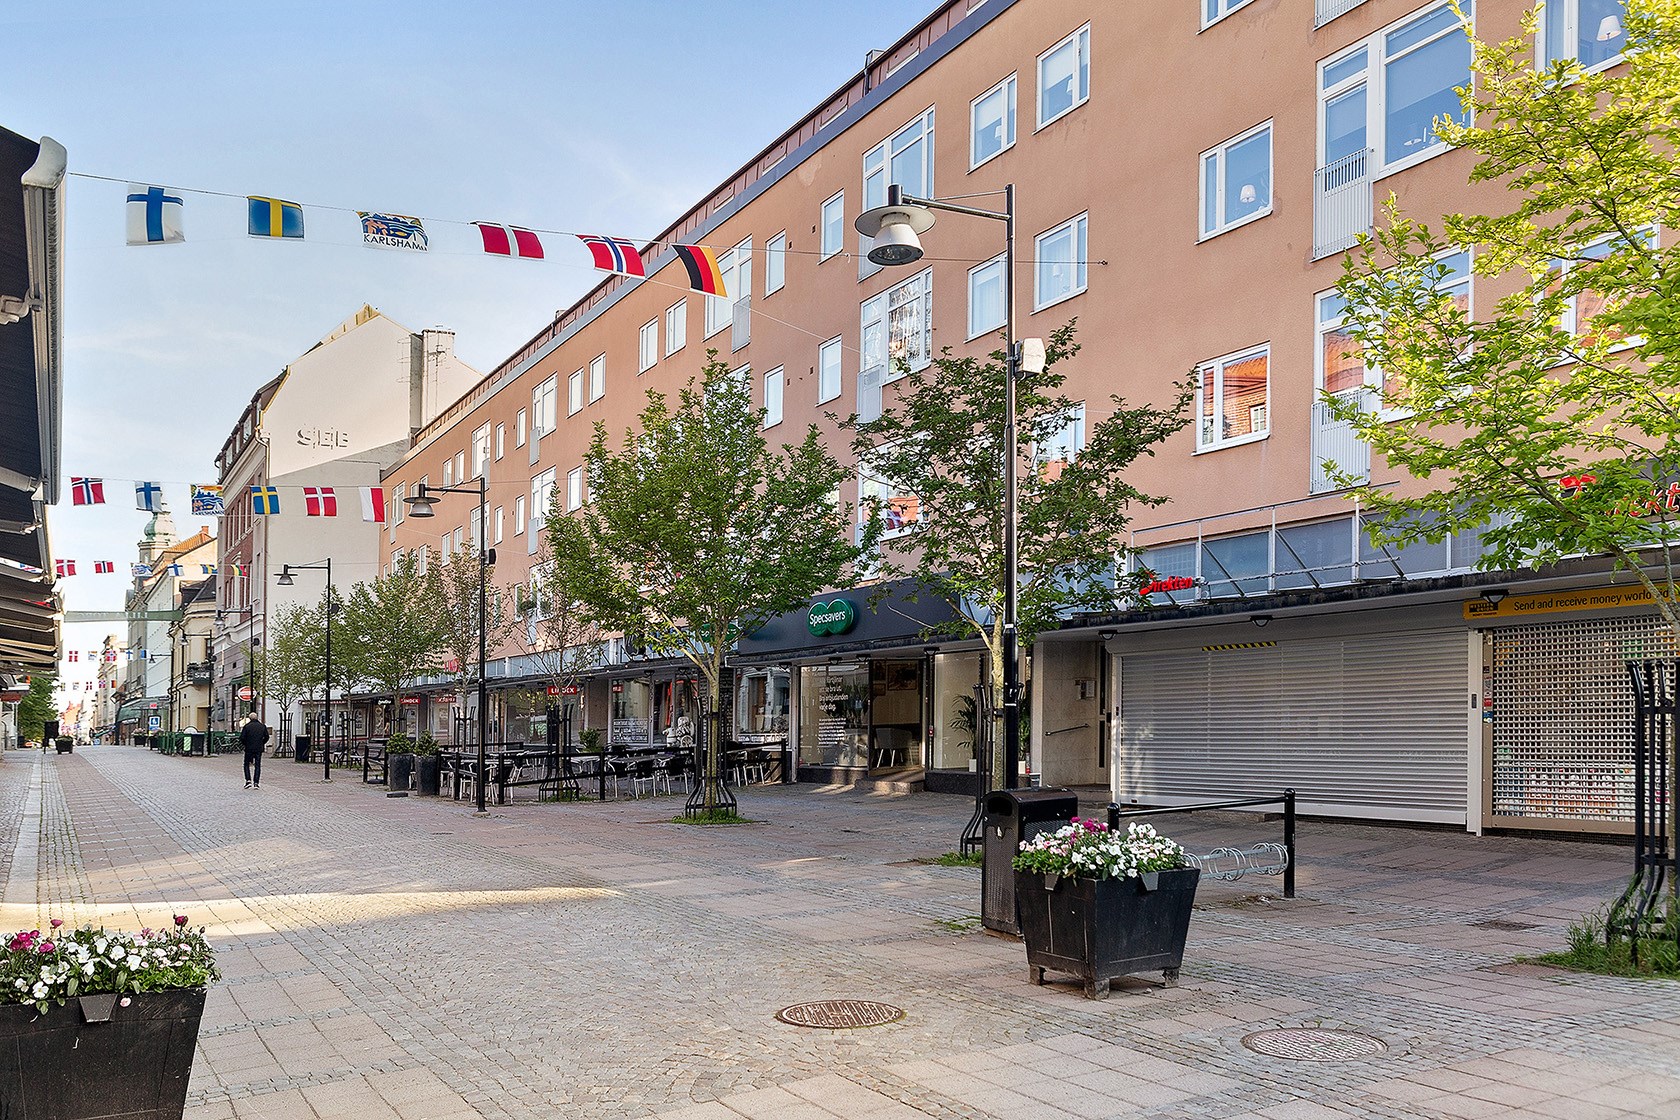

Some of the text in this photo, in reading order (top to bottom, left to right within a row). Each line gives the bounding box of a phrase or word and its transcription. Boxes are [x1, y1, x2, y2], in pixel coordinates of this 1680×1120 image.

[1514, 599, 1535, 611] Send
[1537, 598, 1553, 609] and
[1555, 596, 1588, 608] receive
[1590, 594, 1622, 605] money
[810, 611, 846, 627] Specsavers
